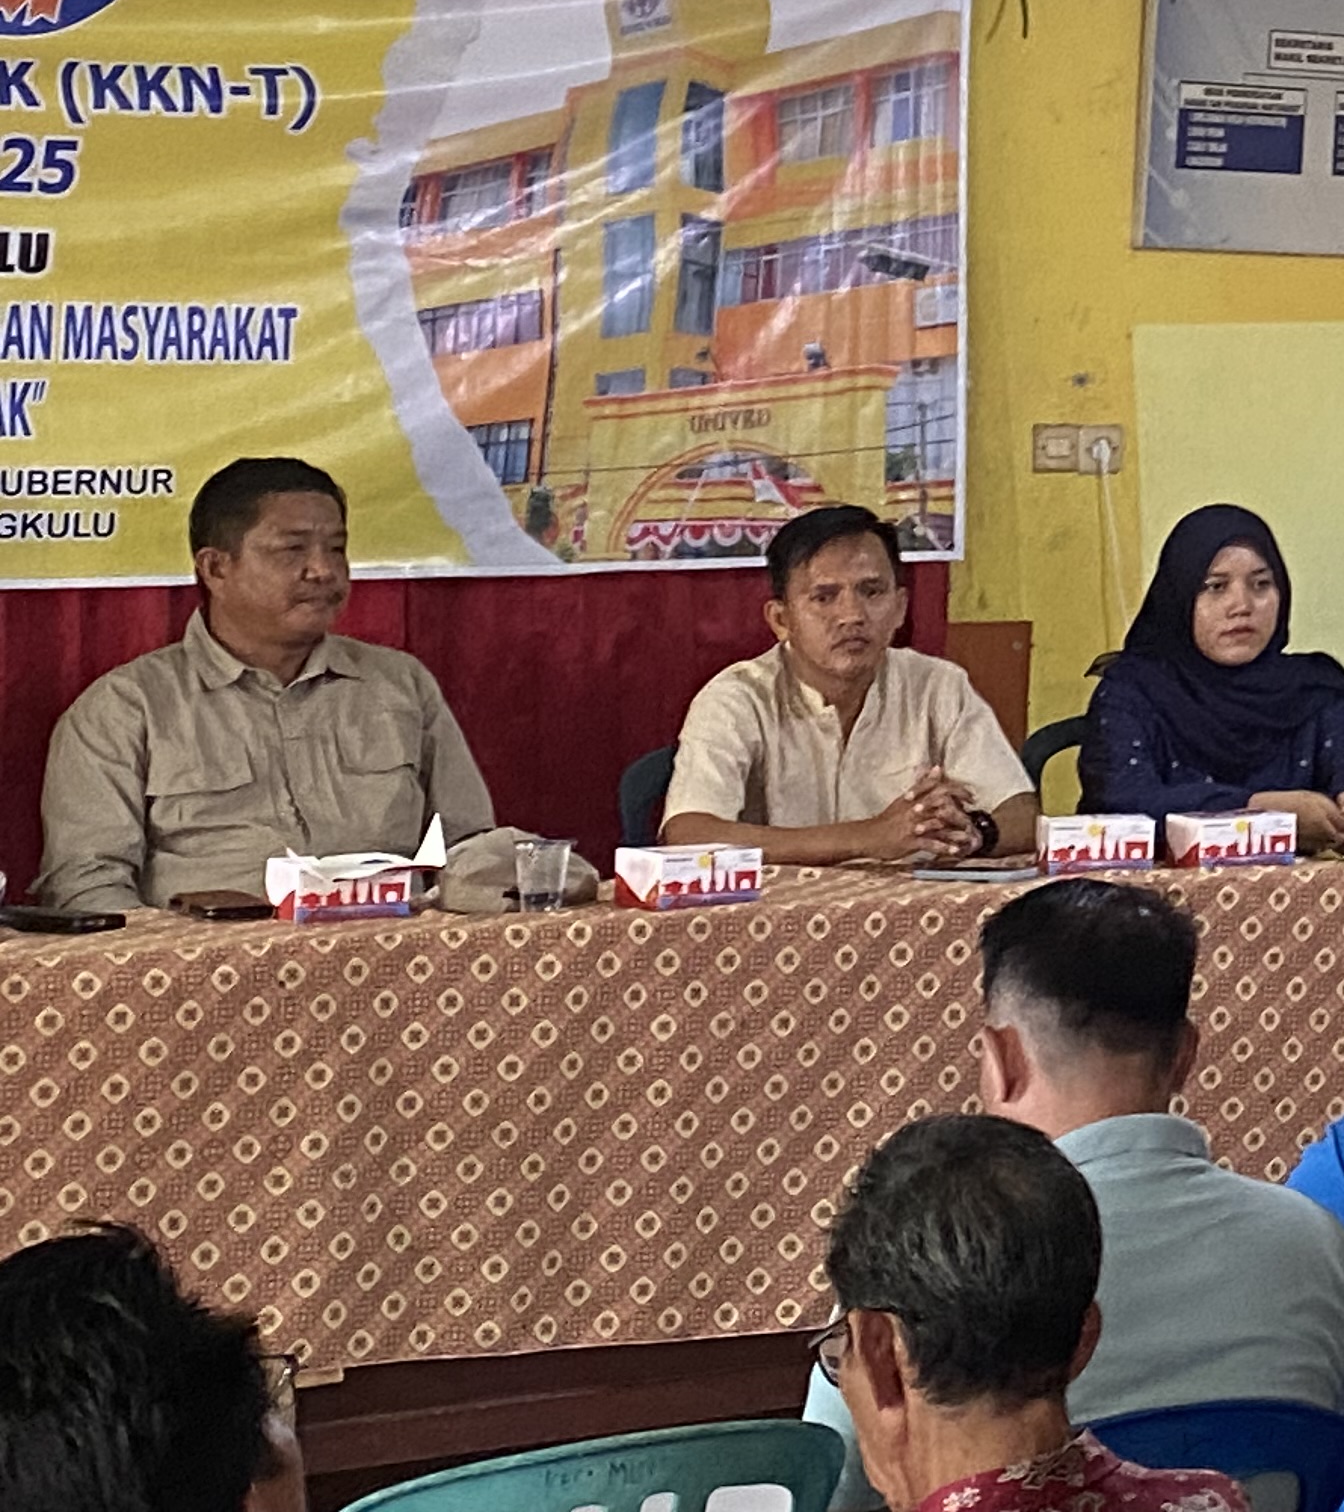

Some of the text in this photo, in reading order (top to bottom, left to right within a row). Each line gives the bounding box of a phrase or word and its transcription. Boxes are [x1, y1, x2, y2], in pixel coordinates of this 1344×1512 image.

[61, 61, 316, 131] (KKN-T)
[0, 138, 78, 194] 25
[62, 304, 297, 361] MASYARAKAT
[0, 380, 46, 437] K"
